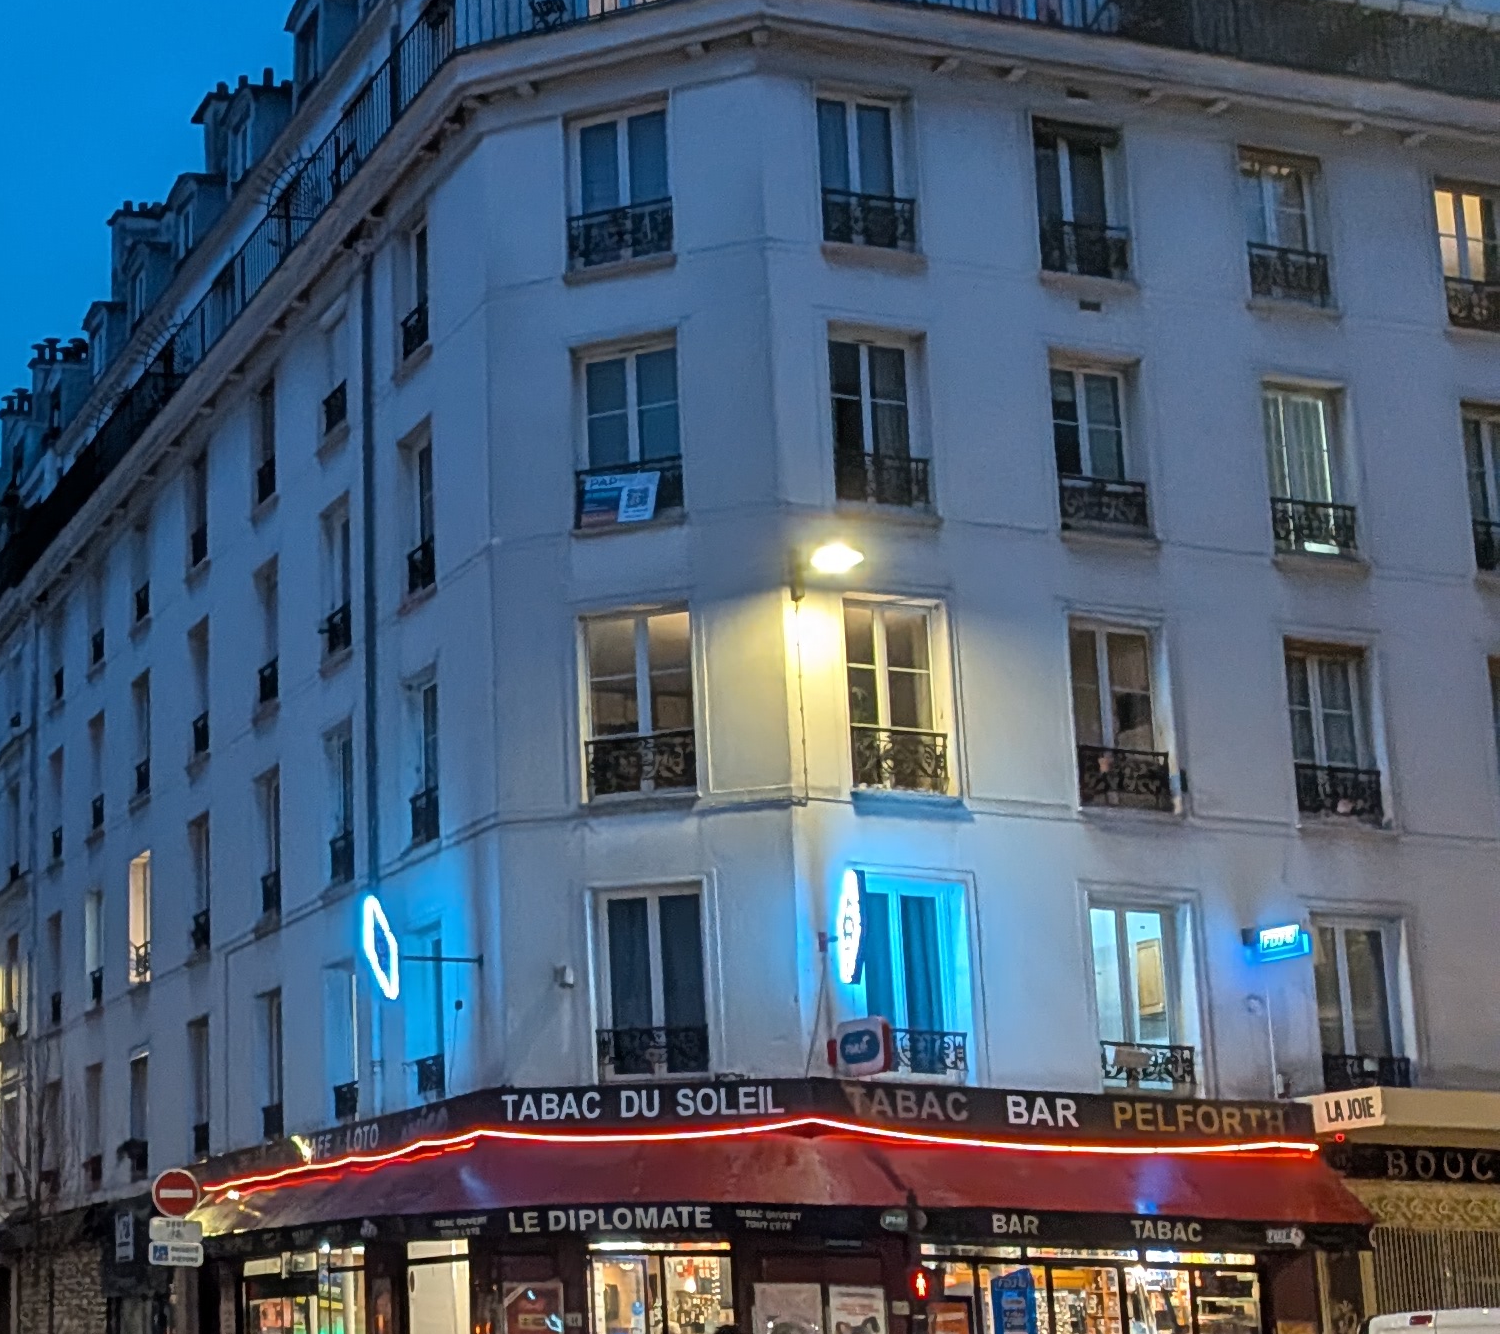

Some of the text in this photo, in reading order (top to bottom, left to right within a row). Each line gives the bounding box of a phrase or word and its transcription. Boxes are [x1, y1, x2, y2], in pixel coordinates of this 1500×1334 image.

[501, 1085, 785, 1122] TABAC DU SOLEIL
[848, 1086, 1287, 1136] TABAC BAR PELFORTH
[1325, 1096, 1375, 1124] LA JOIE
[345, 1122, 380, 1154] LOTO
[1385, 1149, 1494, 1181] BOUC
[508, 1205, 713, 1235] LE DIPLOMATE
[991, 1213, 1040, 1235] BAR
[1130, 1219, 1202, 1243] TABAC
